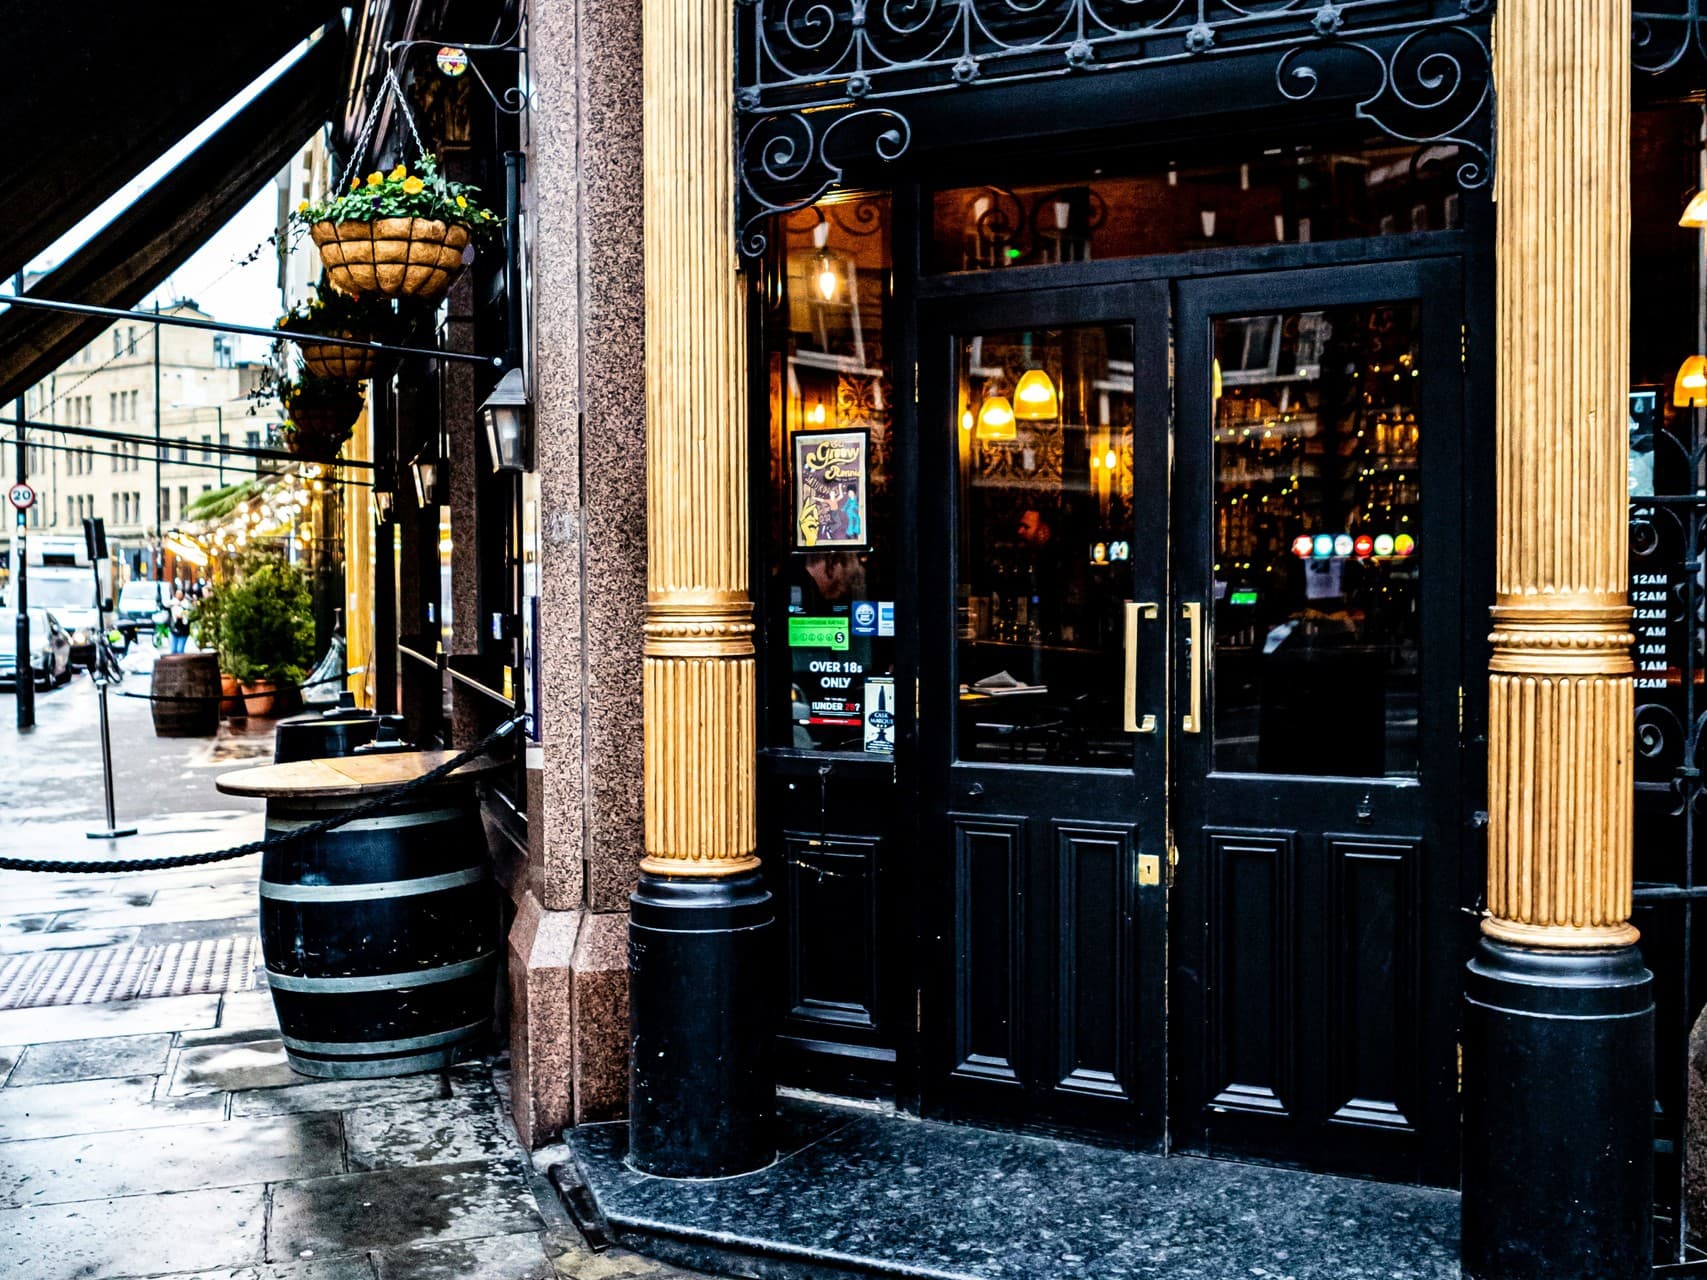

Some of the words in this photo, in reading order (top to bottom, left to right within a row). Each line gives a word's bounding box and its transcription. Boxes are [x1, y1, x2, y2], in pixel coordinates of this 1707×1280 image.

[13, 490, 31, 500] 20
[1632, 574, 1668, 585] 12AM
[1632, 591, 1667, 602] 12AM
[836, 633, 844, 642] 5
[1638, 644, 1666, 654] 1AM
[809, 661, 840, 673] OVER
[843, 662, 863, 673] 18s
[1640, 661, 1668, 671] 1AM
[820, 677, 852, 689] ONLY
[1633, 678, 1668, 688] 12AM
